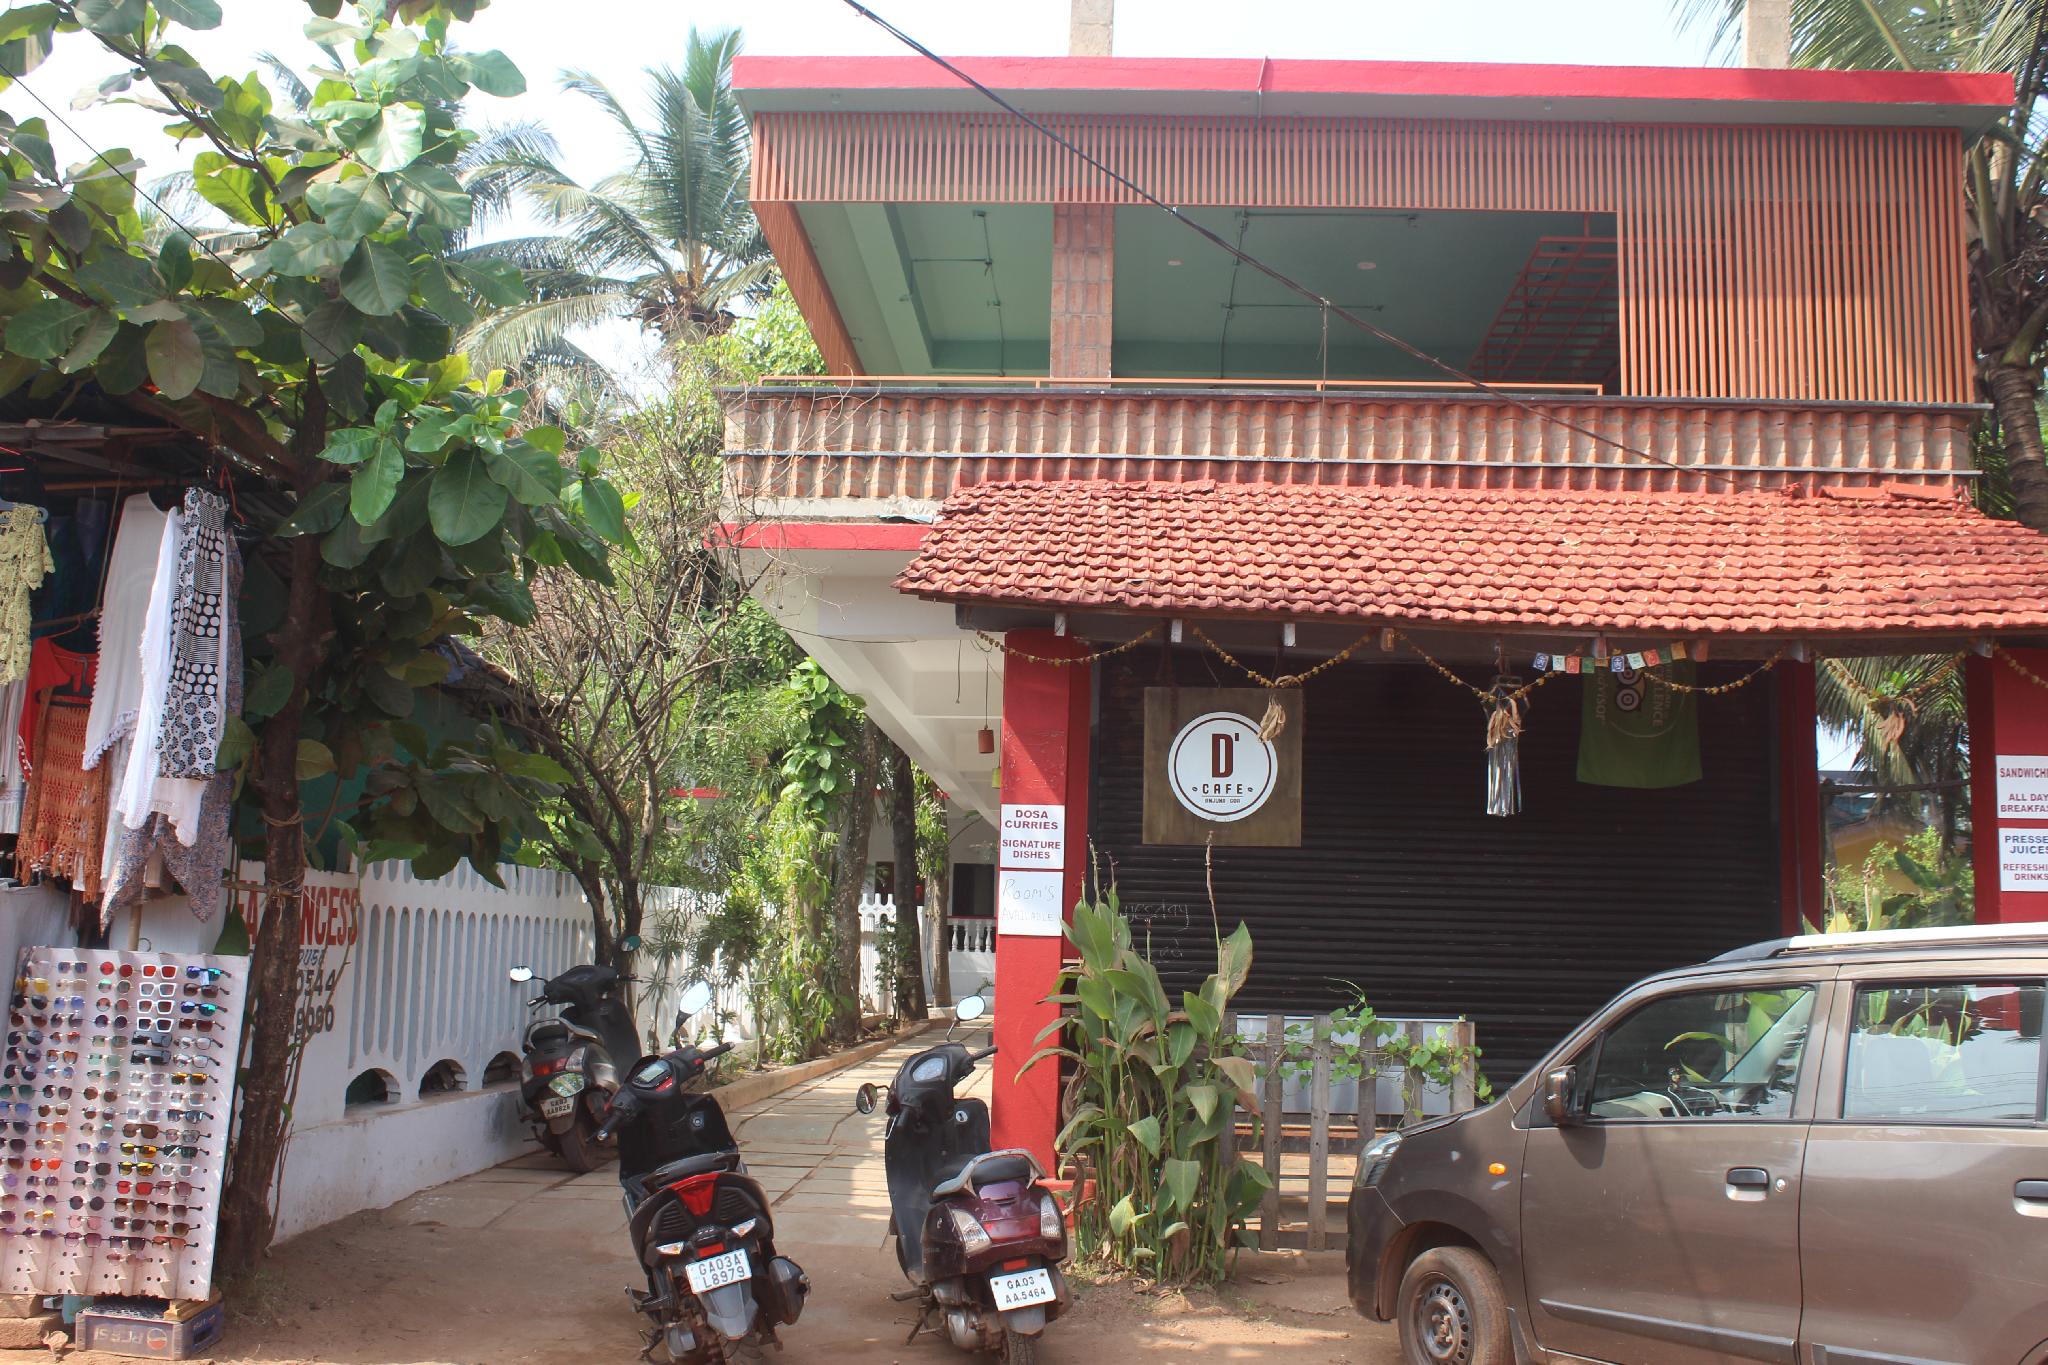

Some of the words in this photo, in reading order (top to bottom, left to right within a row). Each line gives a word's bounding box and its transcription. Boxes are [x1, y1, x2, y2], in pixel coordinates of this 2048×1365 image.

[1211, 732, 1240, 778] D'
[1202, 783, 1243, 795] CAFE
[2008, 793, 2028, 802] ALL
[2030, 793, 2048, 802] DAY
[1015, 809, 1049, 819] DOSA
[1004, 819, 1059, 830] CURRIES
[1002, 839, 1061, 850] SIGNATURE
[1013, 850, 1051, 860] DISHES
[698, 1253, 741, 1276] GA03A
[702, 1265, 745, 1288] L8979
